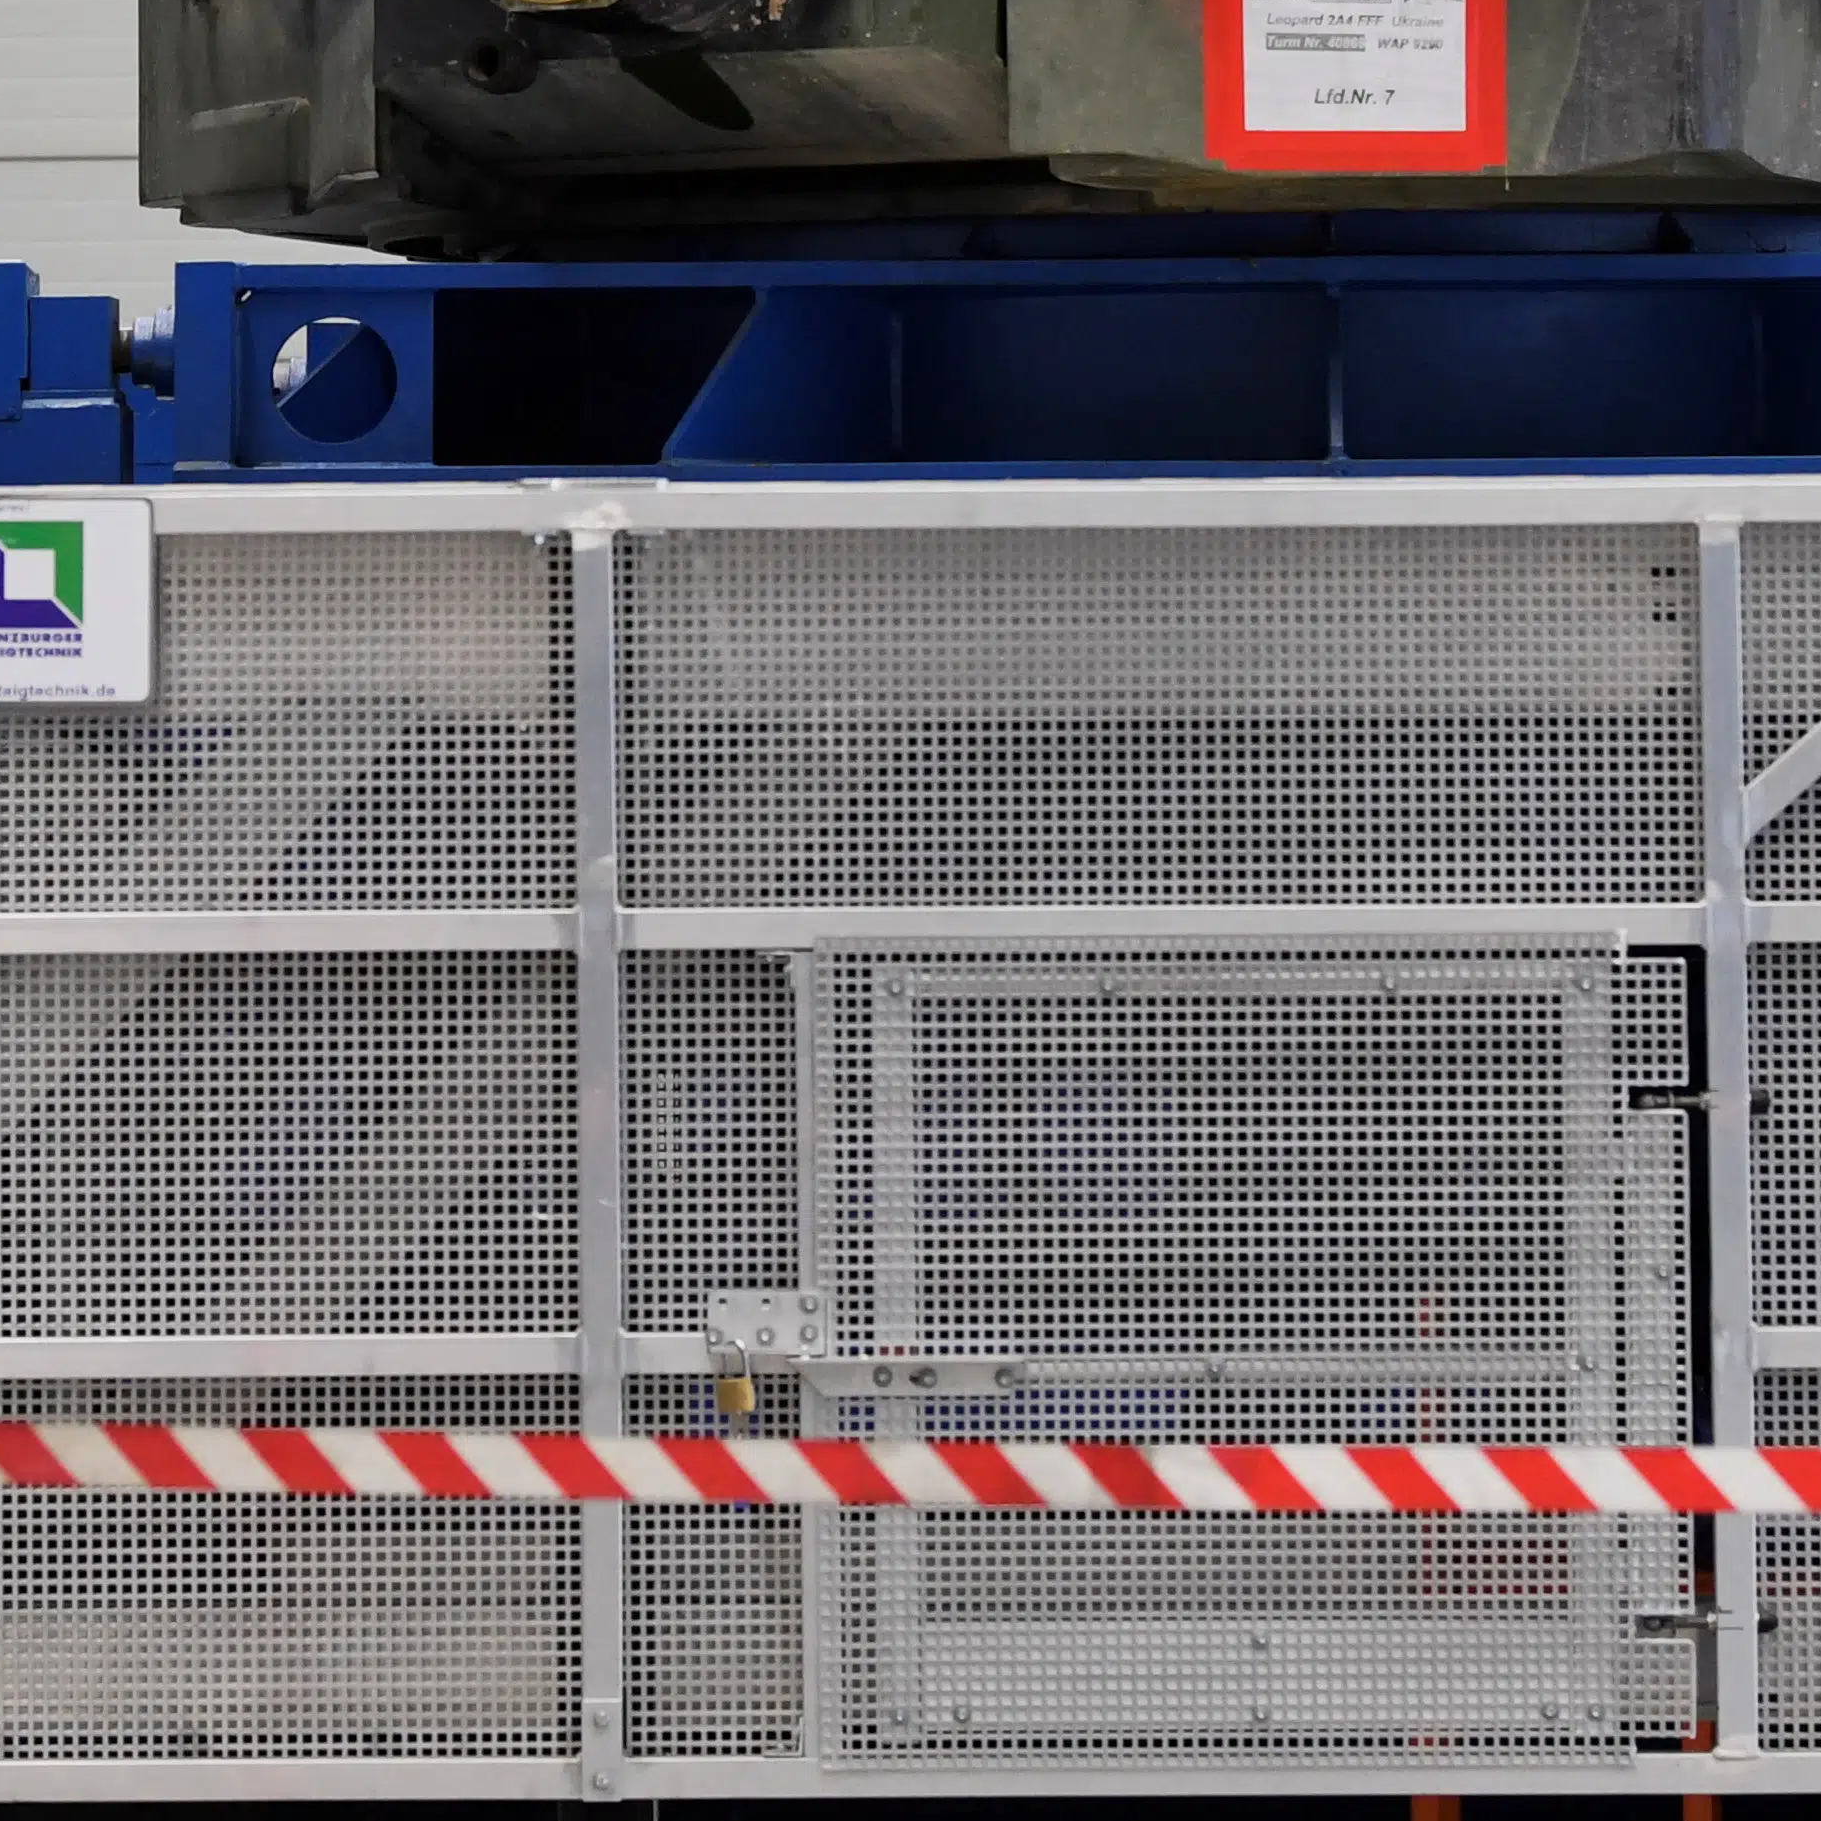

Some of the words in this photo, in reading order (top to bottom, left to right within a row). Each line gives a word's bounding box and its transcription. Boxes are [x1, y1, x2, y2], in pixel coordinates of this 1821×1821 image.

[1266, 13, 1324, 28] Leopard
[1327, 14, 1353, 26] 2A4
[1357, 14, 1384, 26] FFF
[1391, 14, 1444, 27] Ukraine
[1267, 35, 1301, 48] Turm
[1314, 88, 1377, 105] Lfd.Nr.
[1384, 89, 1396, 105] 7
